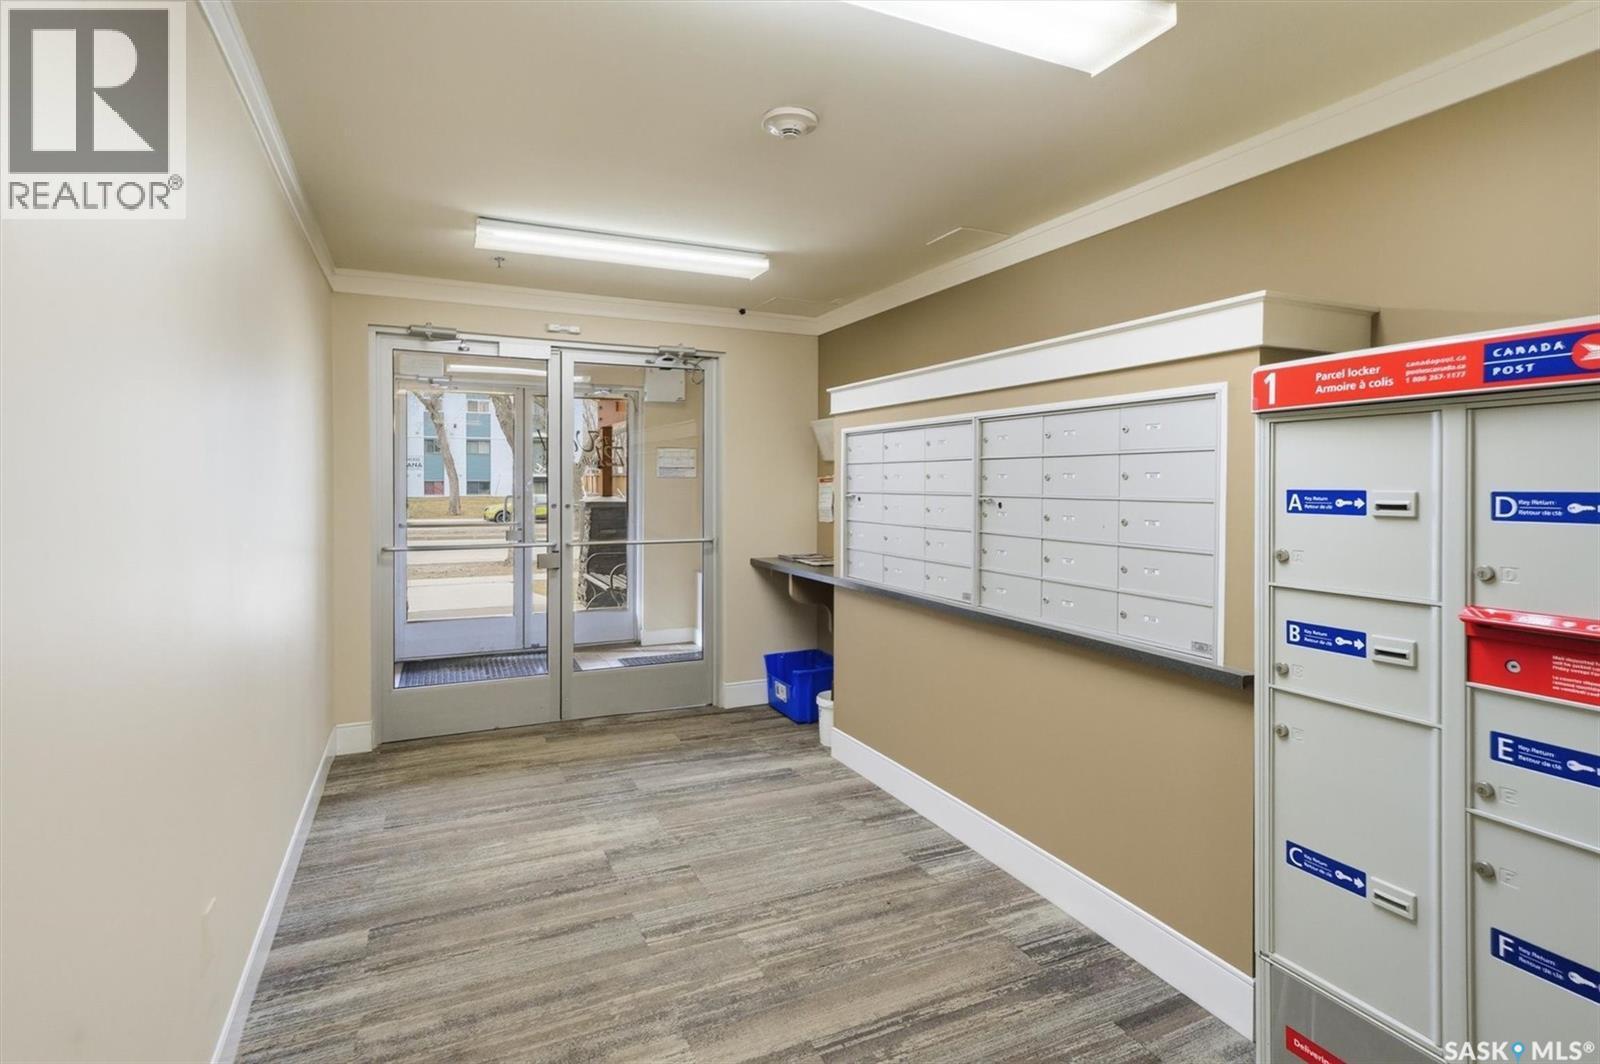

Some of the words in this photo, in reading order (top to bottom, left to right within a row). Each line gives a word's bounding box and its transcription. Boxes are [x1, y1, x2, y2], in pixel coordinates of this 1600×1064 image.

[1492, 341, 1566, 357] CANADA
[1315, 369, 1345, 382] Parcel
[1348, 365, 1381, 378] locker
[1492, 363, 1536, 376] POST
[1263, 372, 1276, 405] 1
[1315, 382, 1357, 394] Armoire
[1358, 379, 1366, 389] à
[1368, 377, 1394, 388] colis
[1288, 493, 1302, 511] A
[1495, 496, 1518, 518] D
[1289, 624, 1300, 642] B
[1498, 736, 1514, 762] E
[1289, 847, 1303, 867] C
[1499, 934, 1514, 957] F
